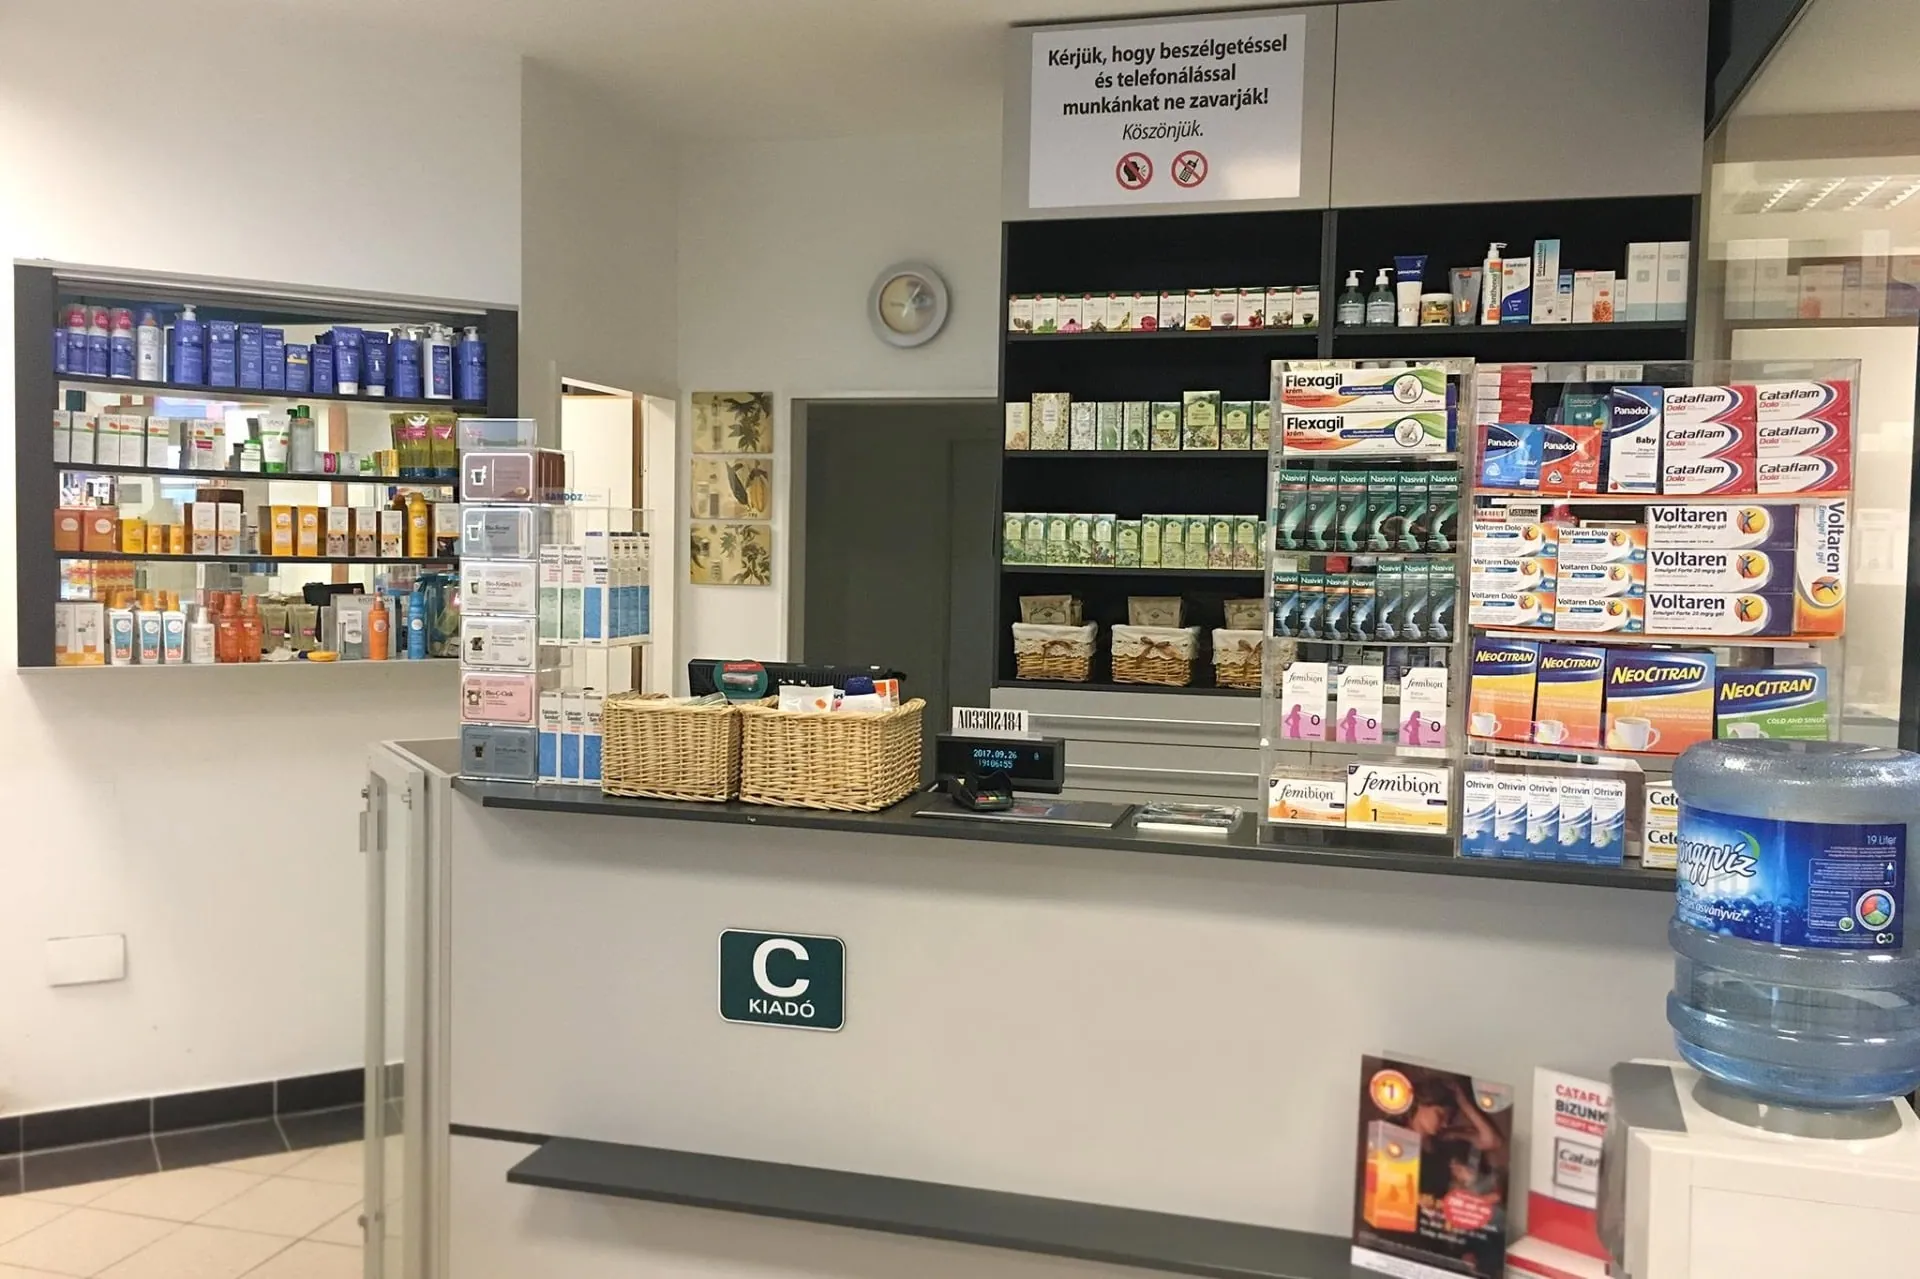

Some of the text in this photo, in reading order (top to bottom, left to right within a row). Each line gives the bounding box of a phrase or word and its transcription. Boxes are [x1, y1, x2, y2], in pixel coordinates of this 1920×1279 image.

[1049, 34, 1287, 69] Kérjük, hogy beszélgetéssel
[1095, 64, 1236, 89] és telefonálással
[1063, 87, 1268, 115] munkánkat ne zavarják!
[1122, 120, 1204, 142] Köszönjük.
[1286, 374, 1342, 390] Flexagil
[1667, 394, 1725, 404] Cataflam
[1759, 390, 1820, 400] Cataflam
[1614, 406, 1648, 415] Panadol
[1287, 416, 1344, 432] Flexagil
[1666, 429, 1724, 439] Cataflam
[1759, 426, 1820, 436] Cataflam
[1488, 438, 1518, 448] Panadol
[1636, 436, 1656, 445] Baby
[1544, 442, 1576, 450] Panadol
[1666, 465, 1724, 474] Cataflam
[1759, 463, 1820, 474] Cataflam
[1282, 474, 1306, 482] Nasivin
[1311, 474, 1336, 482] Nasivin
[1341, 474, 1366, 482] Nasivin
[1370, 474, 1396, 482] Nasivin
[1400, 474, 1426, 482] Nasivin
[1430, 474, 1457, 482] Nasivin
[1652, 508, 1727, 522] Voltaren
[1827, 502, 1845, 572] Voltaren
[1652, 552, 1727, 566] Voltaren
[1650, 594, 1725, 609] Voltaren
[1288, 672, 1323, 684] femibion
[1343, 677, 1379, 688] femibion
[1405, 678, 1443, 690] femibion
[958, 710, 1022, 731] A03302484
[973, 749, 1017, 759] 2017.09.26
[1354, 771, 1440, 796] femibion
[1466, 781, 1494, 789] Otrivin
[1498, 782, 1526, 792] Otrivin
[1529, 784, 1557, 793] Otrivin
[1276, 784, 1334, 801] femibion
[1561, 786, 1590, 795] Otrivin
[1594, 788, 1622, 797] Otrivin
[1290, 810, 1298, 819] 2
[1372, 809, 1378, 821] 1
[1867, 835, 1896, 844] 19 Liter
[753, 938, 810, 998] C
[749, 999, 815, 1018] KIADÓ
